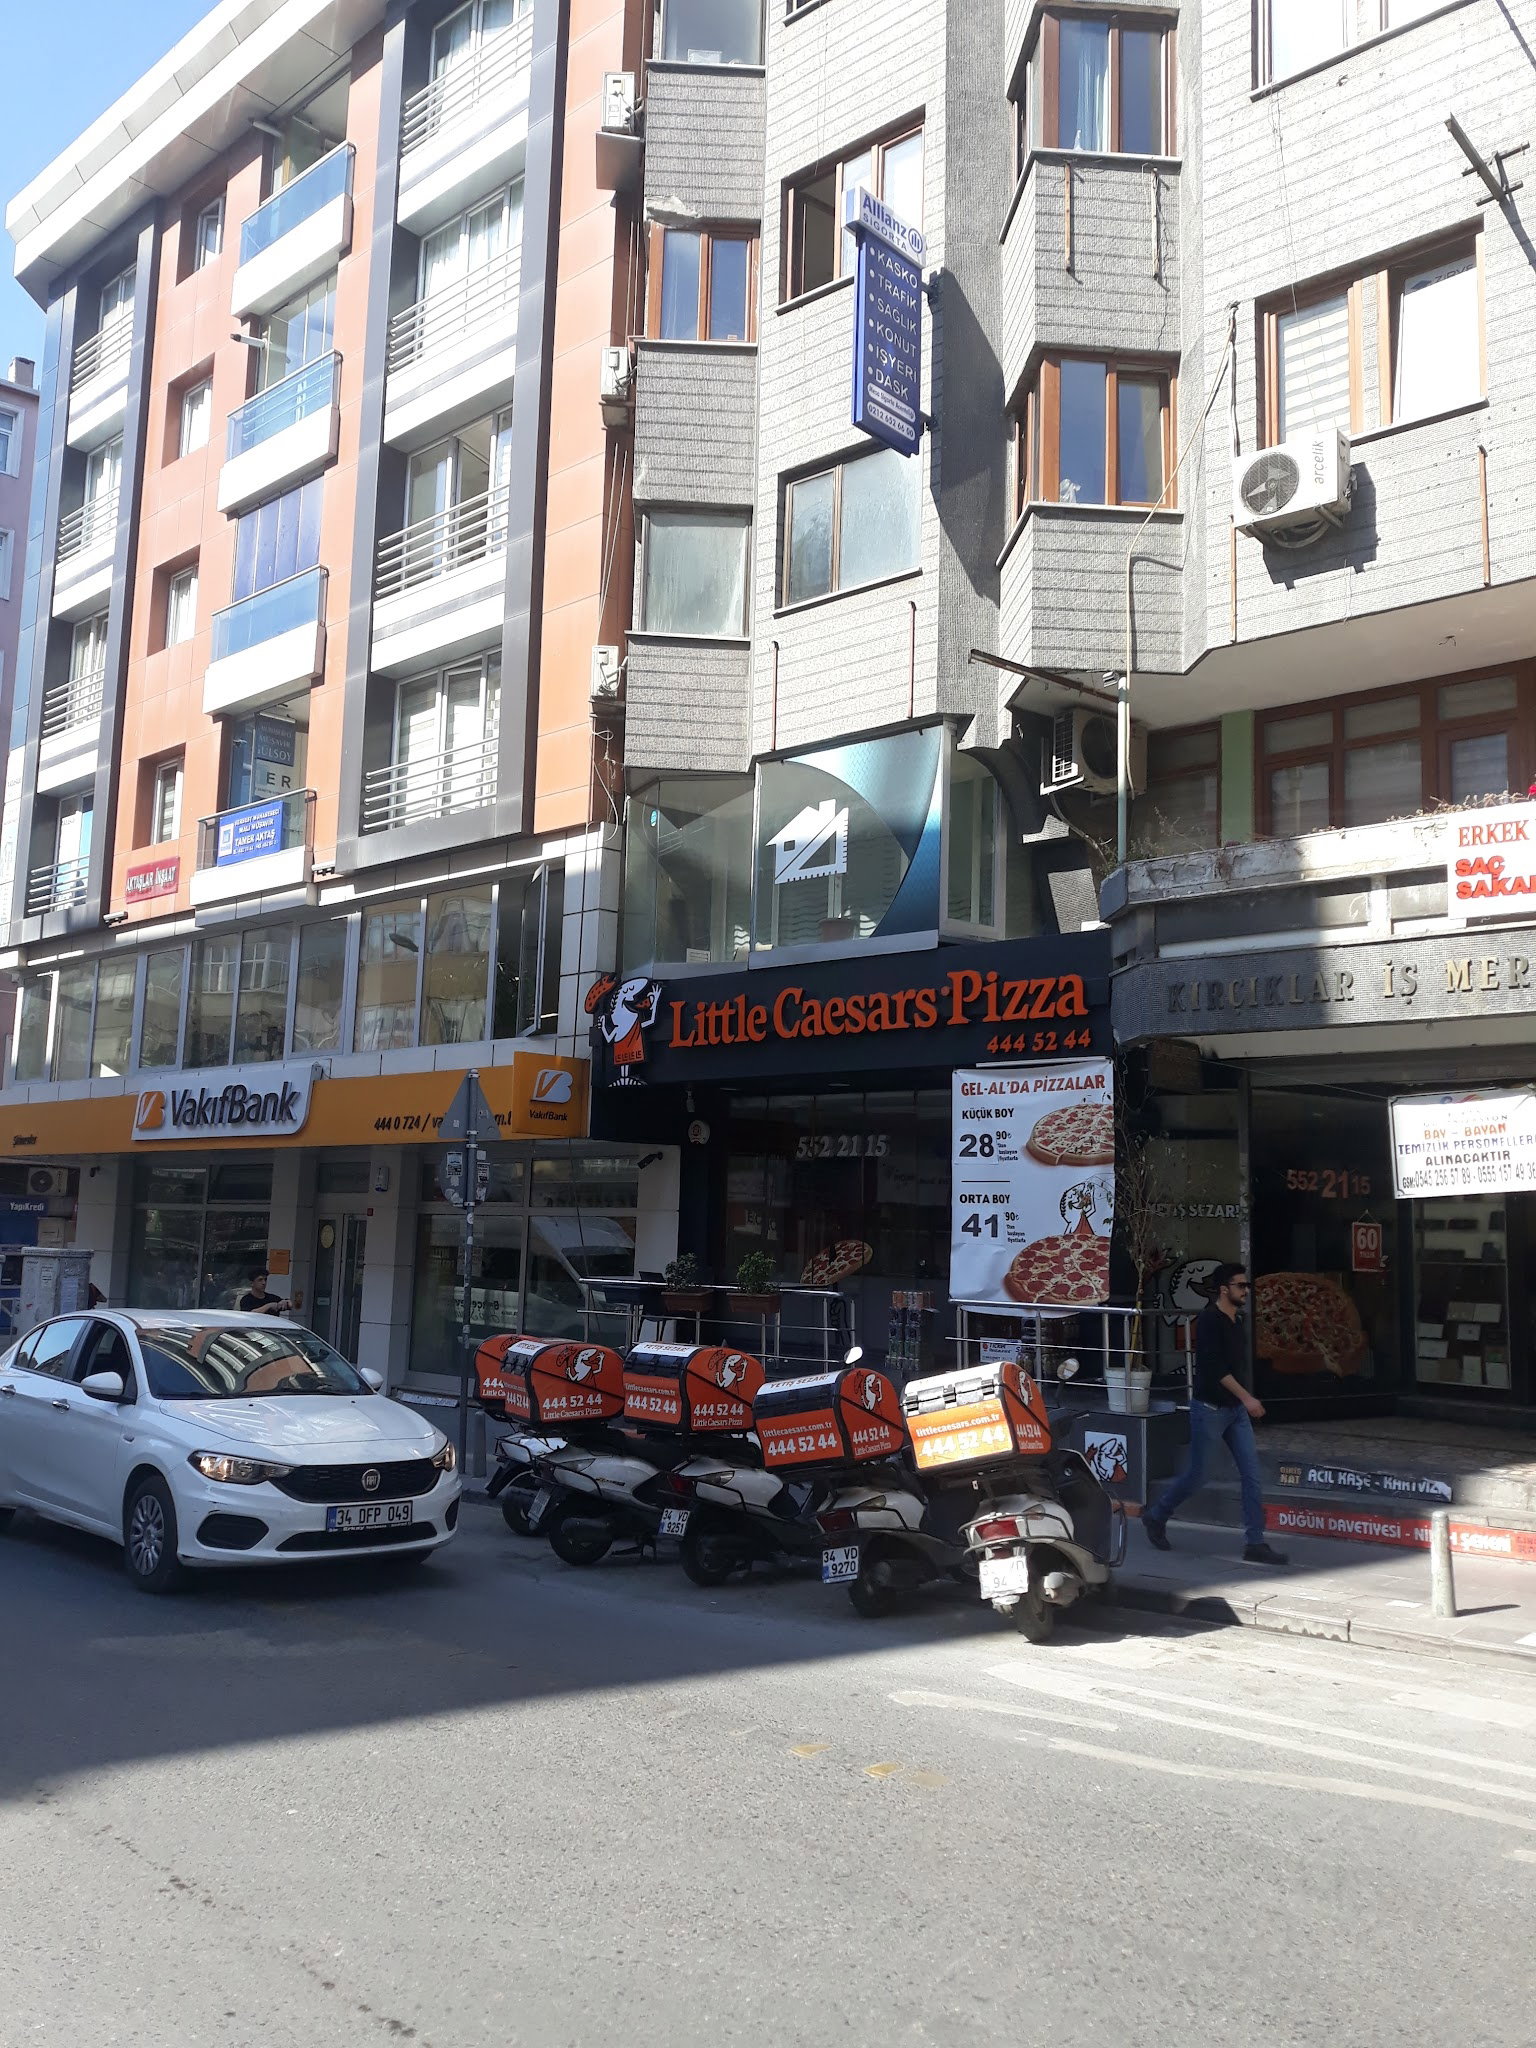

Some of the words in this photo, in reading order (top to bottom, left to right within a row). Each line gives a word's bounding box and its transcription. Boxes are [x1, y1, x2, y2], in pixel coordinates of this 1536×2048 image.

[863, 193, 907, 240] Allianz
[878, 250, 917, 289] KASKO
[878, 273, 917, 312] TRAFİK
[878, 297, 917, 335] SAĞLIK
[876, 321, 917, 357] KONUT
[876, 342, 917, 383] İŞYERİ
[876, 368, 909, 401] DASK
[1458, 819, 1531, 848] ERKEK
[1455, 855, 1505, 880] SAÇ
[1167, 970, 1355, 1016] KIRÇIKLAR
[1382, 959, 1418, 1005] İŞ
[1445, 953, 1531, 994] MER
[668, 993, 768, 1049] Little
[773, 986, 939, 1039] Caesars
[946, 969, 1089, 1026] Pizza
[986, 1033, 1026, 1054] 444
[1031, 1031, 1058, 1051] 52
[1063, 1028, 1092, 1049] 44
[1033, 1074, 1106, 1093] PİZZALAR
[171, 1081, 301, 1128] VakıfBank
[961, 1106, 993, 1122] KÜÇÜK
[995, 1107, 1015, 1119] BOY
[374, 1115, 391, 1131] 444
[393, 1115, 401, 1130] 0
[402, 1114, 421, 1130] 724
[1424, 1129, 1446, 1140] BAY
[1464, 1123, 1507, 1137] BAYAN
[836, 1134, 859, 1157] 21
[864, 1134, 889, 1157] 15
[958, 1133, 995, 1158] 28
[1425, 1150, 1511, 1167] ALINACAKTIR
[1286, 1168, 1319, 1191] 552
[1321, 1168, 1350, 1199] 21
[1351, 1175, 1371, 1195] 15
[959, 1193, 990, 1204] ORTA
[992, 1193, 1011, 1204] BOY
[961, 1213, 999, 1238] 41
[1356, 1226, 1378, 1251] 60
[542, 1397, 568, 1410] 444
[570, 1395, 584, 1408] 52
[586, 1393, 603, 1406] 44
[543, 1411, 561, 1420] Little
[560, 1409, 585, 1419] Caesars
[585, 1407, 603, 1416] Pizza
[627, 1394, 648, 1410] 444
[649, 1397, 662, 1412] 52
[663, 1399, 678, 1415] 44
[693, 1403, 715, 1417] 444
[716, 1403, 729, 1416] 52
[730, 1403, 744, 1416] 44
[693, 1418, 708, 1427] Little
[707, 1418, 728, 1427] Caesars
[763, 1421, 833, 1438] littlecaesars.com.tr
[852, 1429, 869, 1445] 444
[868, 1427, 879, 1442] 52
[879, 1425, 890, 1439] 44
[915, 1412, 1000, 1438] littlecaesars.com.tr
[1016, 1423, 1028, 1438] 444
[767, 1438, 797, 1457] 444
[797, 1435, 816, 1453] 52
[818, 1432, 838, 1449] 44
[921, 1436, 957, 1457] 444
[957, 1431, 980, 1450] 52
[981, 1425, 1006, 1445] 44
[337, 1509, 353, 1526] 34
[359, 1507, 381, 1524] DFP
[387, 1505, 410, 1522] 049
[662, 1509, 672, 1521] 34
[1278, 1510, 1325, 1530] DÜĞÜN
[1328, 1514, 1402, 1539] DAVETİYESİ
[666, 1522, 685, 1534] 9251
[823, 1550, 836, 1563] 34
[843, 1547, 858, 1560] VD
[831, 1560, 856, 1575] 9270
